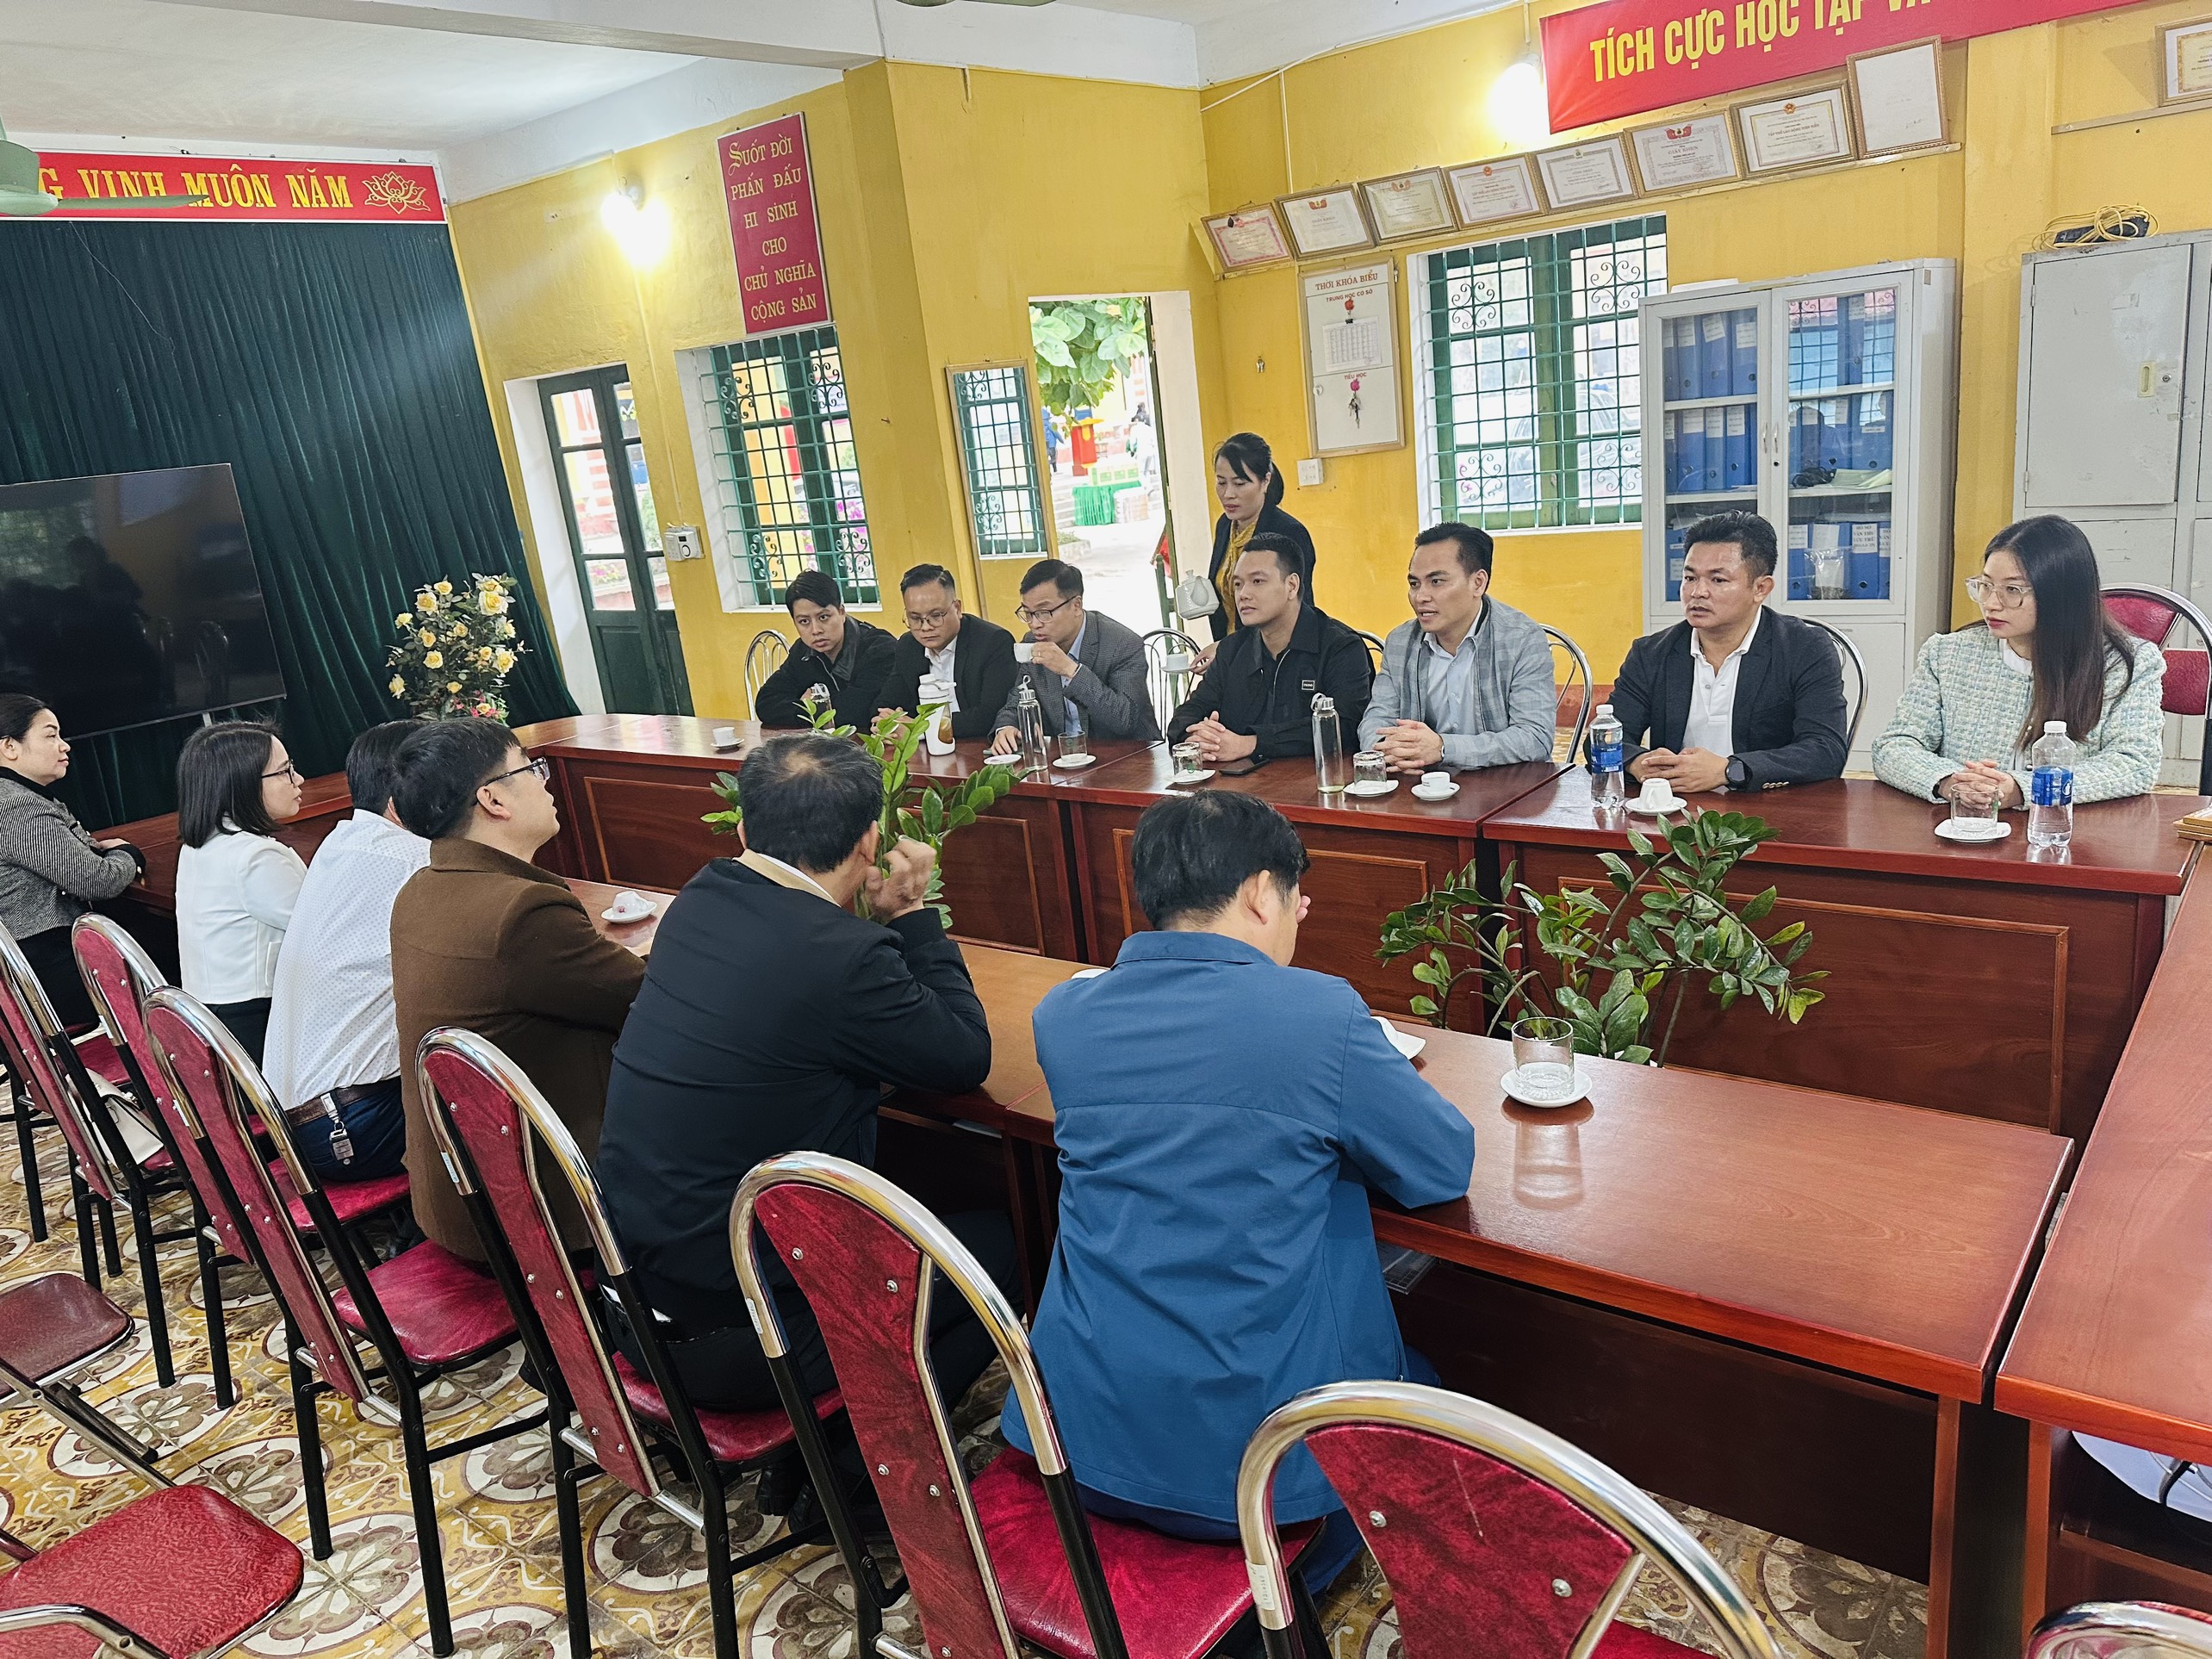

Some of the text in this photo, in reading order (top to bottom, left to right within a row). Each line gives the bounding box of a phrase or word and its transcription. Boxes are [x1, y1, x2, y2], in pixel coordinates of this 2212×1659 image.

[1589, 28, 1655, 83] TÍCH
[1664, 9, 1724, 70] CỰC
[1736, 0, 1799, 53] HỌC
[770, 134, 792, 158] ĐỜI
[77, 169, 168, 199] VINH
[181, 163, 276, 208] MUÔN
[284, 167, 354, 208] NĂM
[730, 163, 801, 201] PHẤN ĐẤU
[743, 202, 798, 229] HI SINH
[762, 237, 787, 256] CHO
[744, 259, 817, 291] CHỦ NGHĨA
[1315, 269, 1378, 290] THỜI KHÓA BIỂU
[751, 287, 817, 323] CỘNG SẢN
